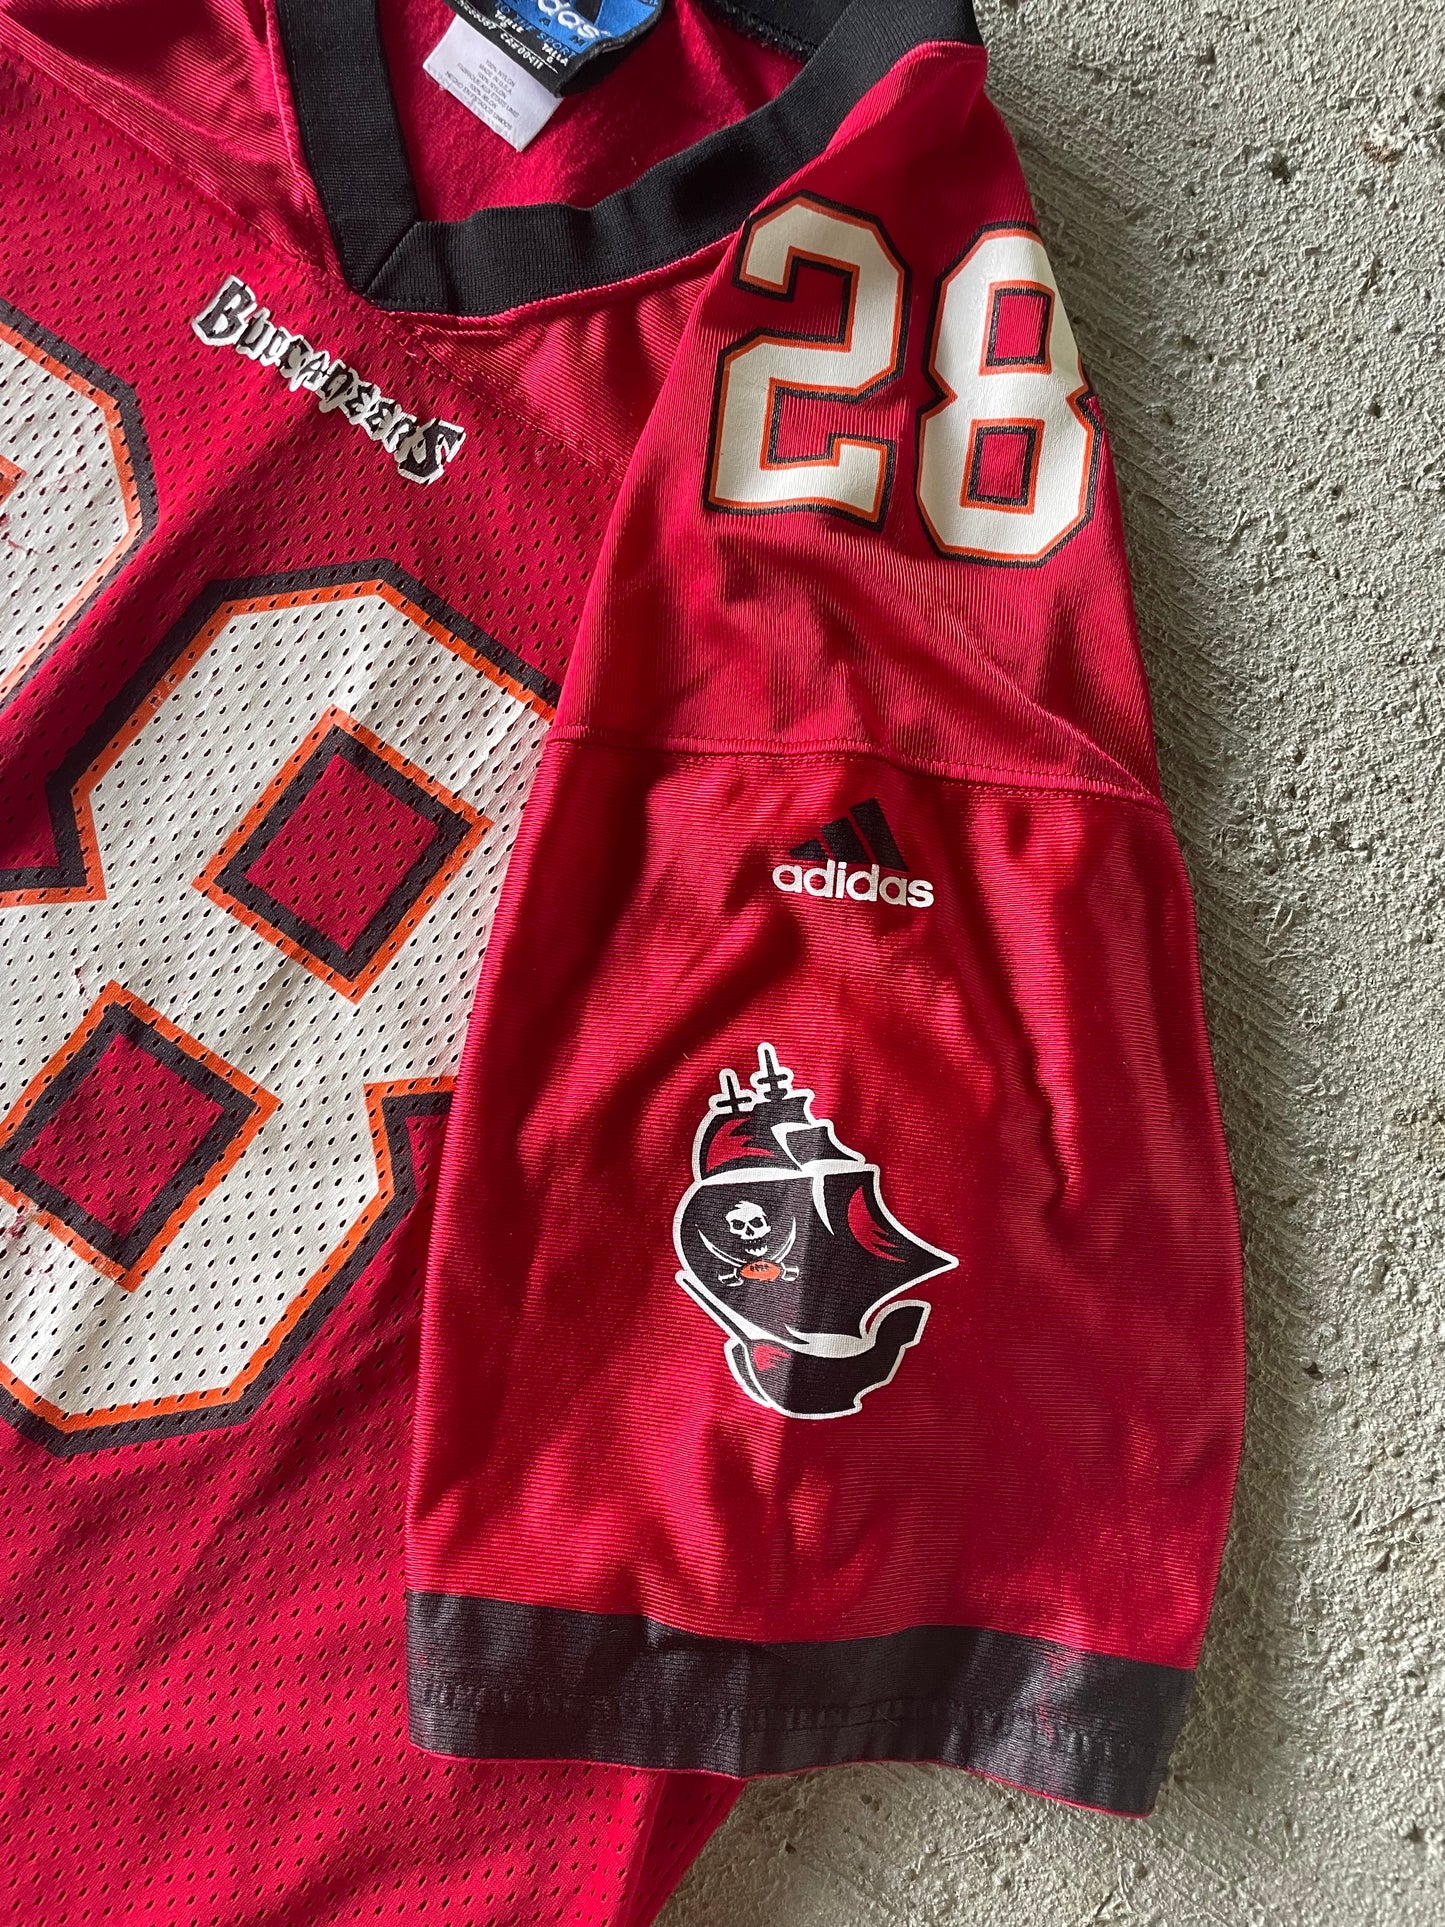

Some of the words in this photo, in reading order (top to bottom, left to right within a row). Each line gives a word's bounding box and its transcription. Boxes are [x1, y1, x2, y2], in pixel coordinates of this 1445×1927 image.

[536, 30, 577, 59] SPORT
[541, 42, 569, 67] TALLA
[479, 63, 493, 79] MADE
[498, 68, 516, 88] NYLON
[490, 80, 507, 100] NYLON
[703, 190, 1102, 569] 28
[772, 858, 935, 908] adidas
